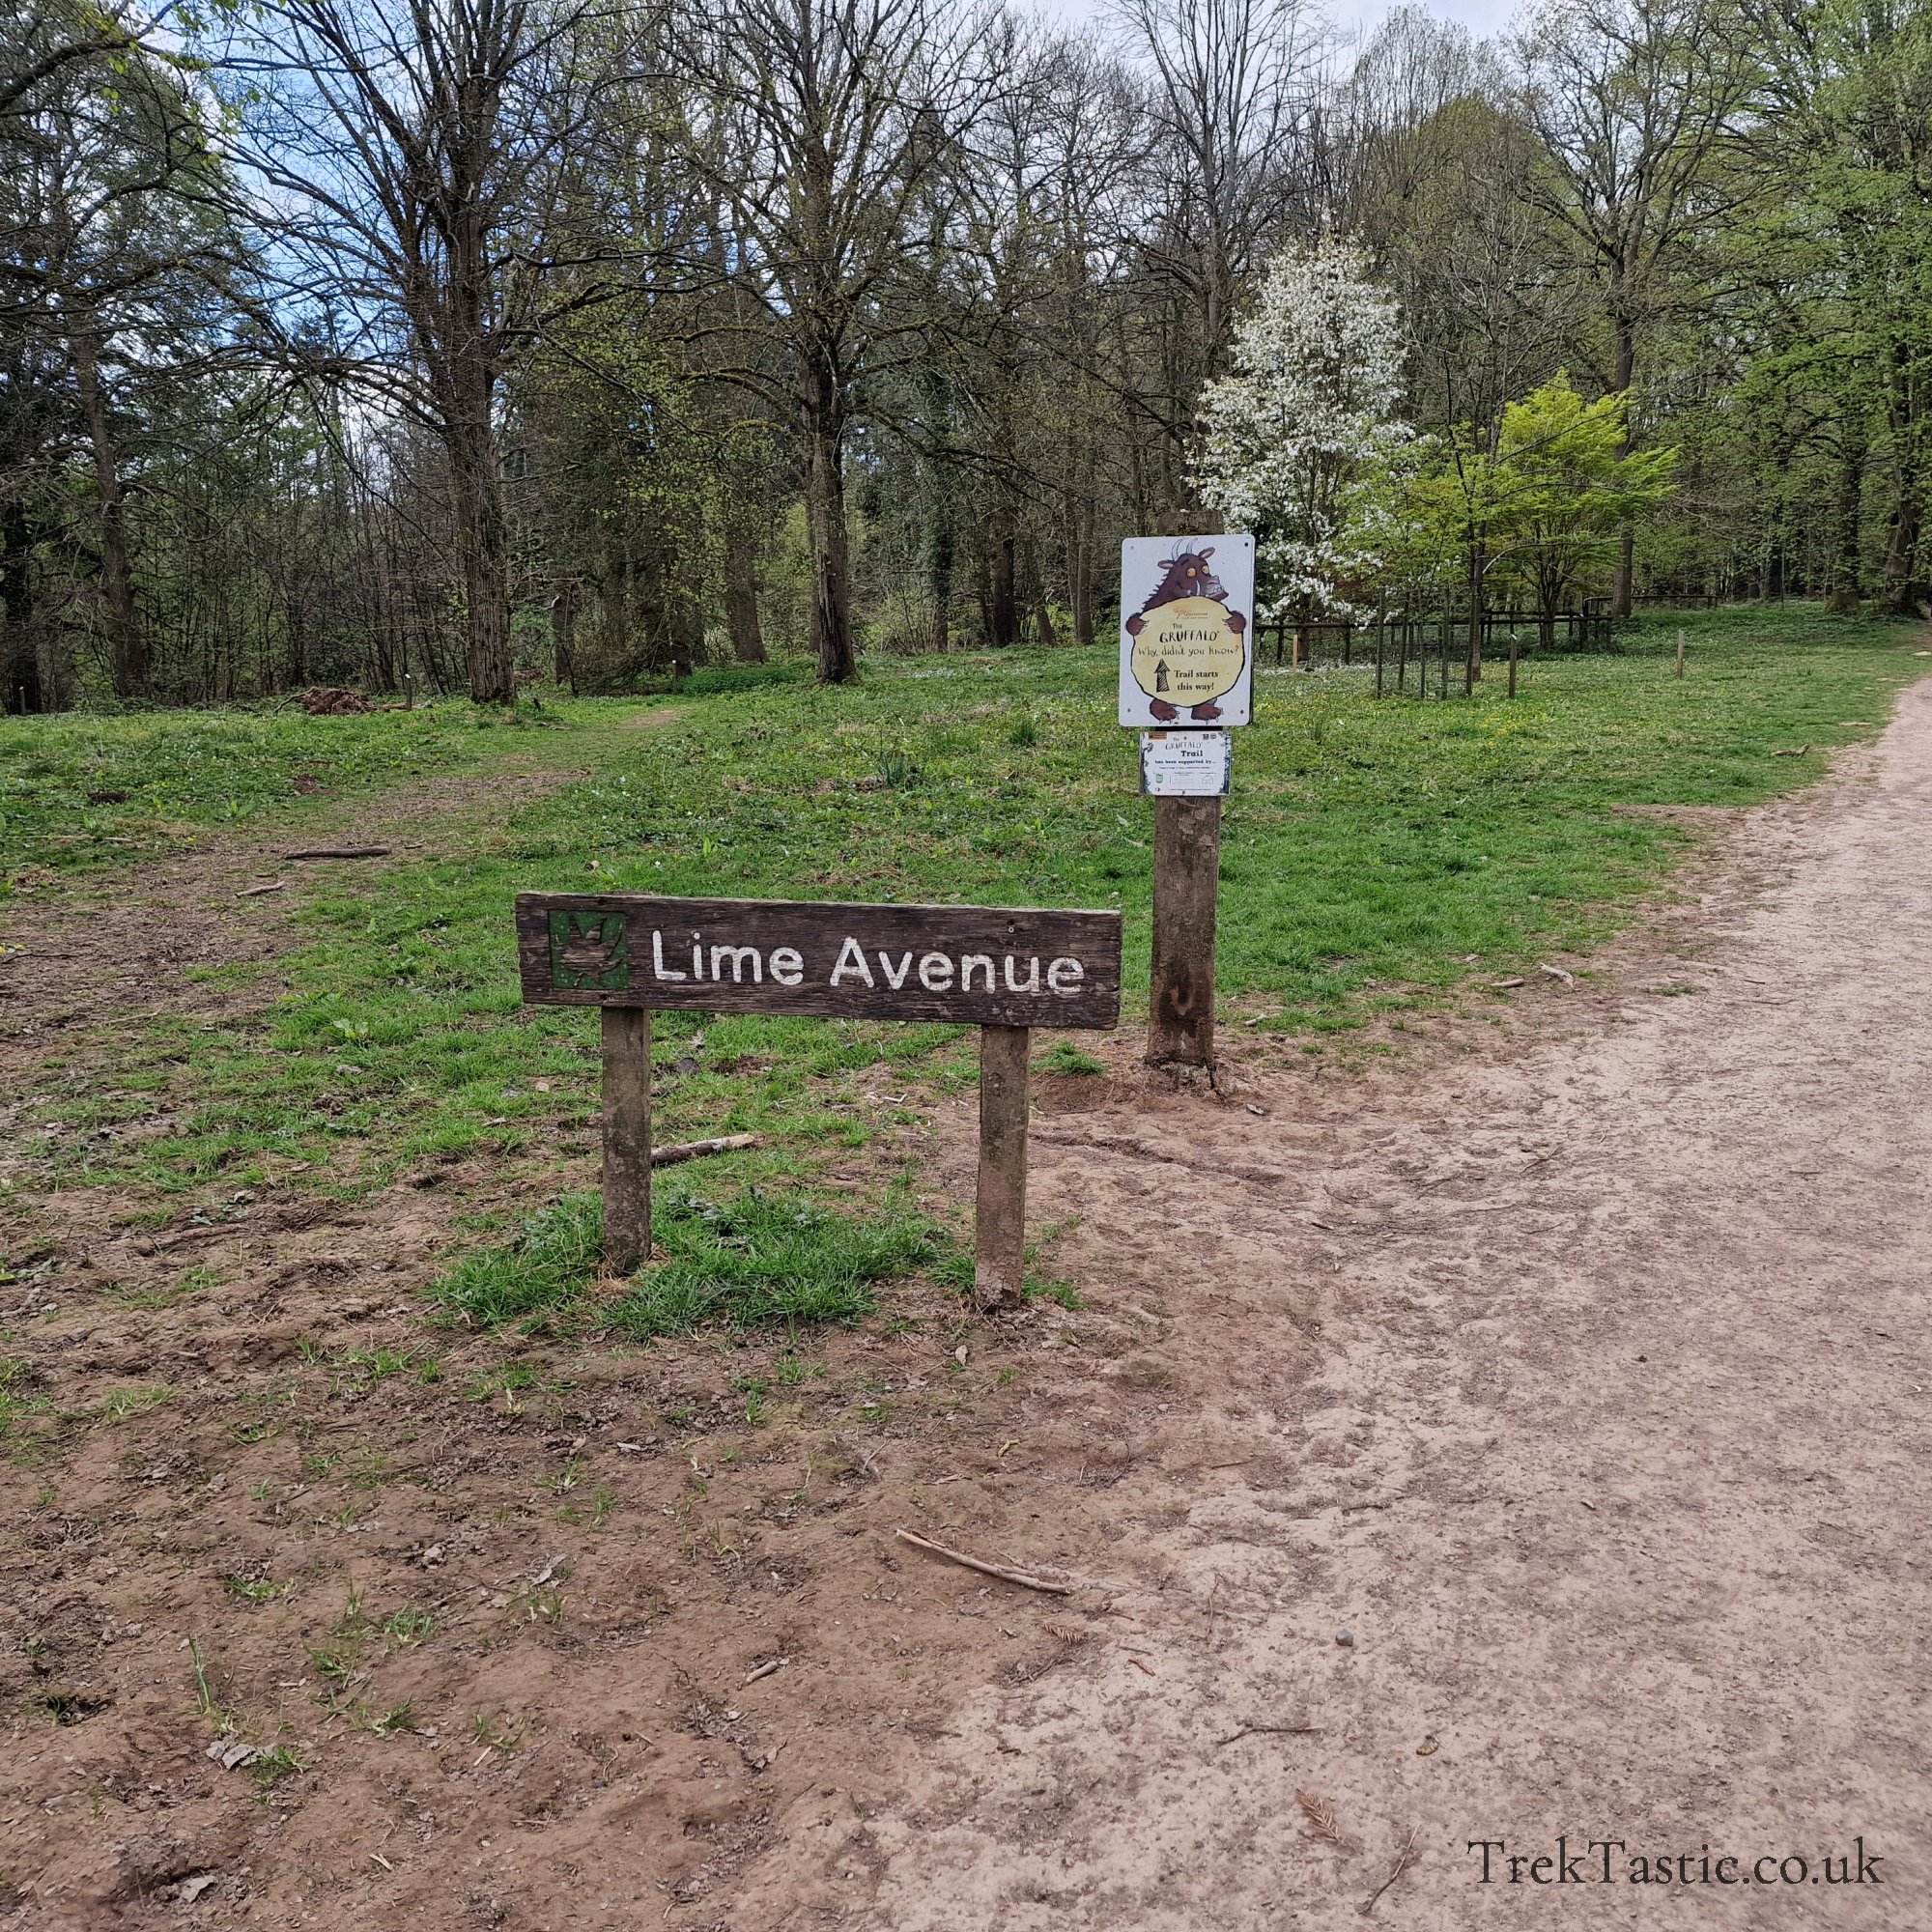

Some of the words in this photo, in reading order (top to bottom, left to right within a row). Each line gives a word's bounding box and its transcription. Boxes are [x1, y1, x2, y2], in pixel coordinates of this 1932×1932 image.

[1161, 644, 1184, 655] didn't
[1188, 648, 1205, 657] you
[1196, 683, 1214, 692] way!
[651, 930, 805, 985] Lime
[829, 936, 1085, 994] Avenue
